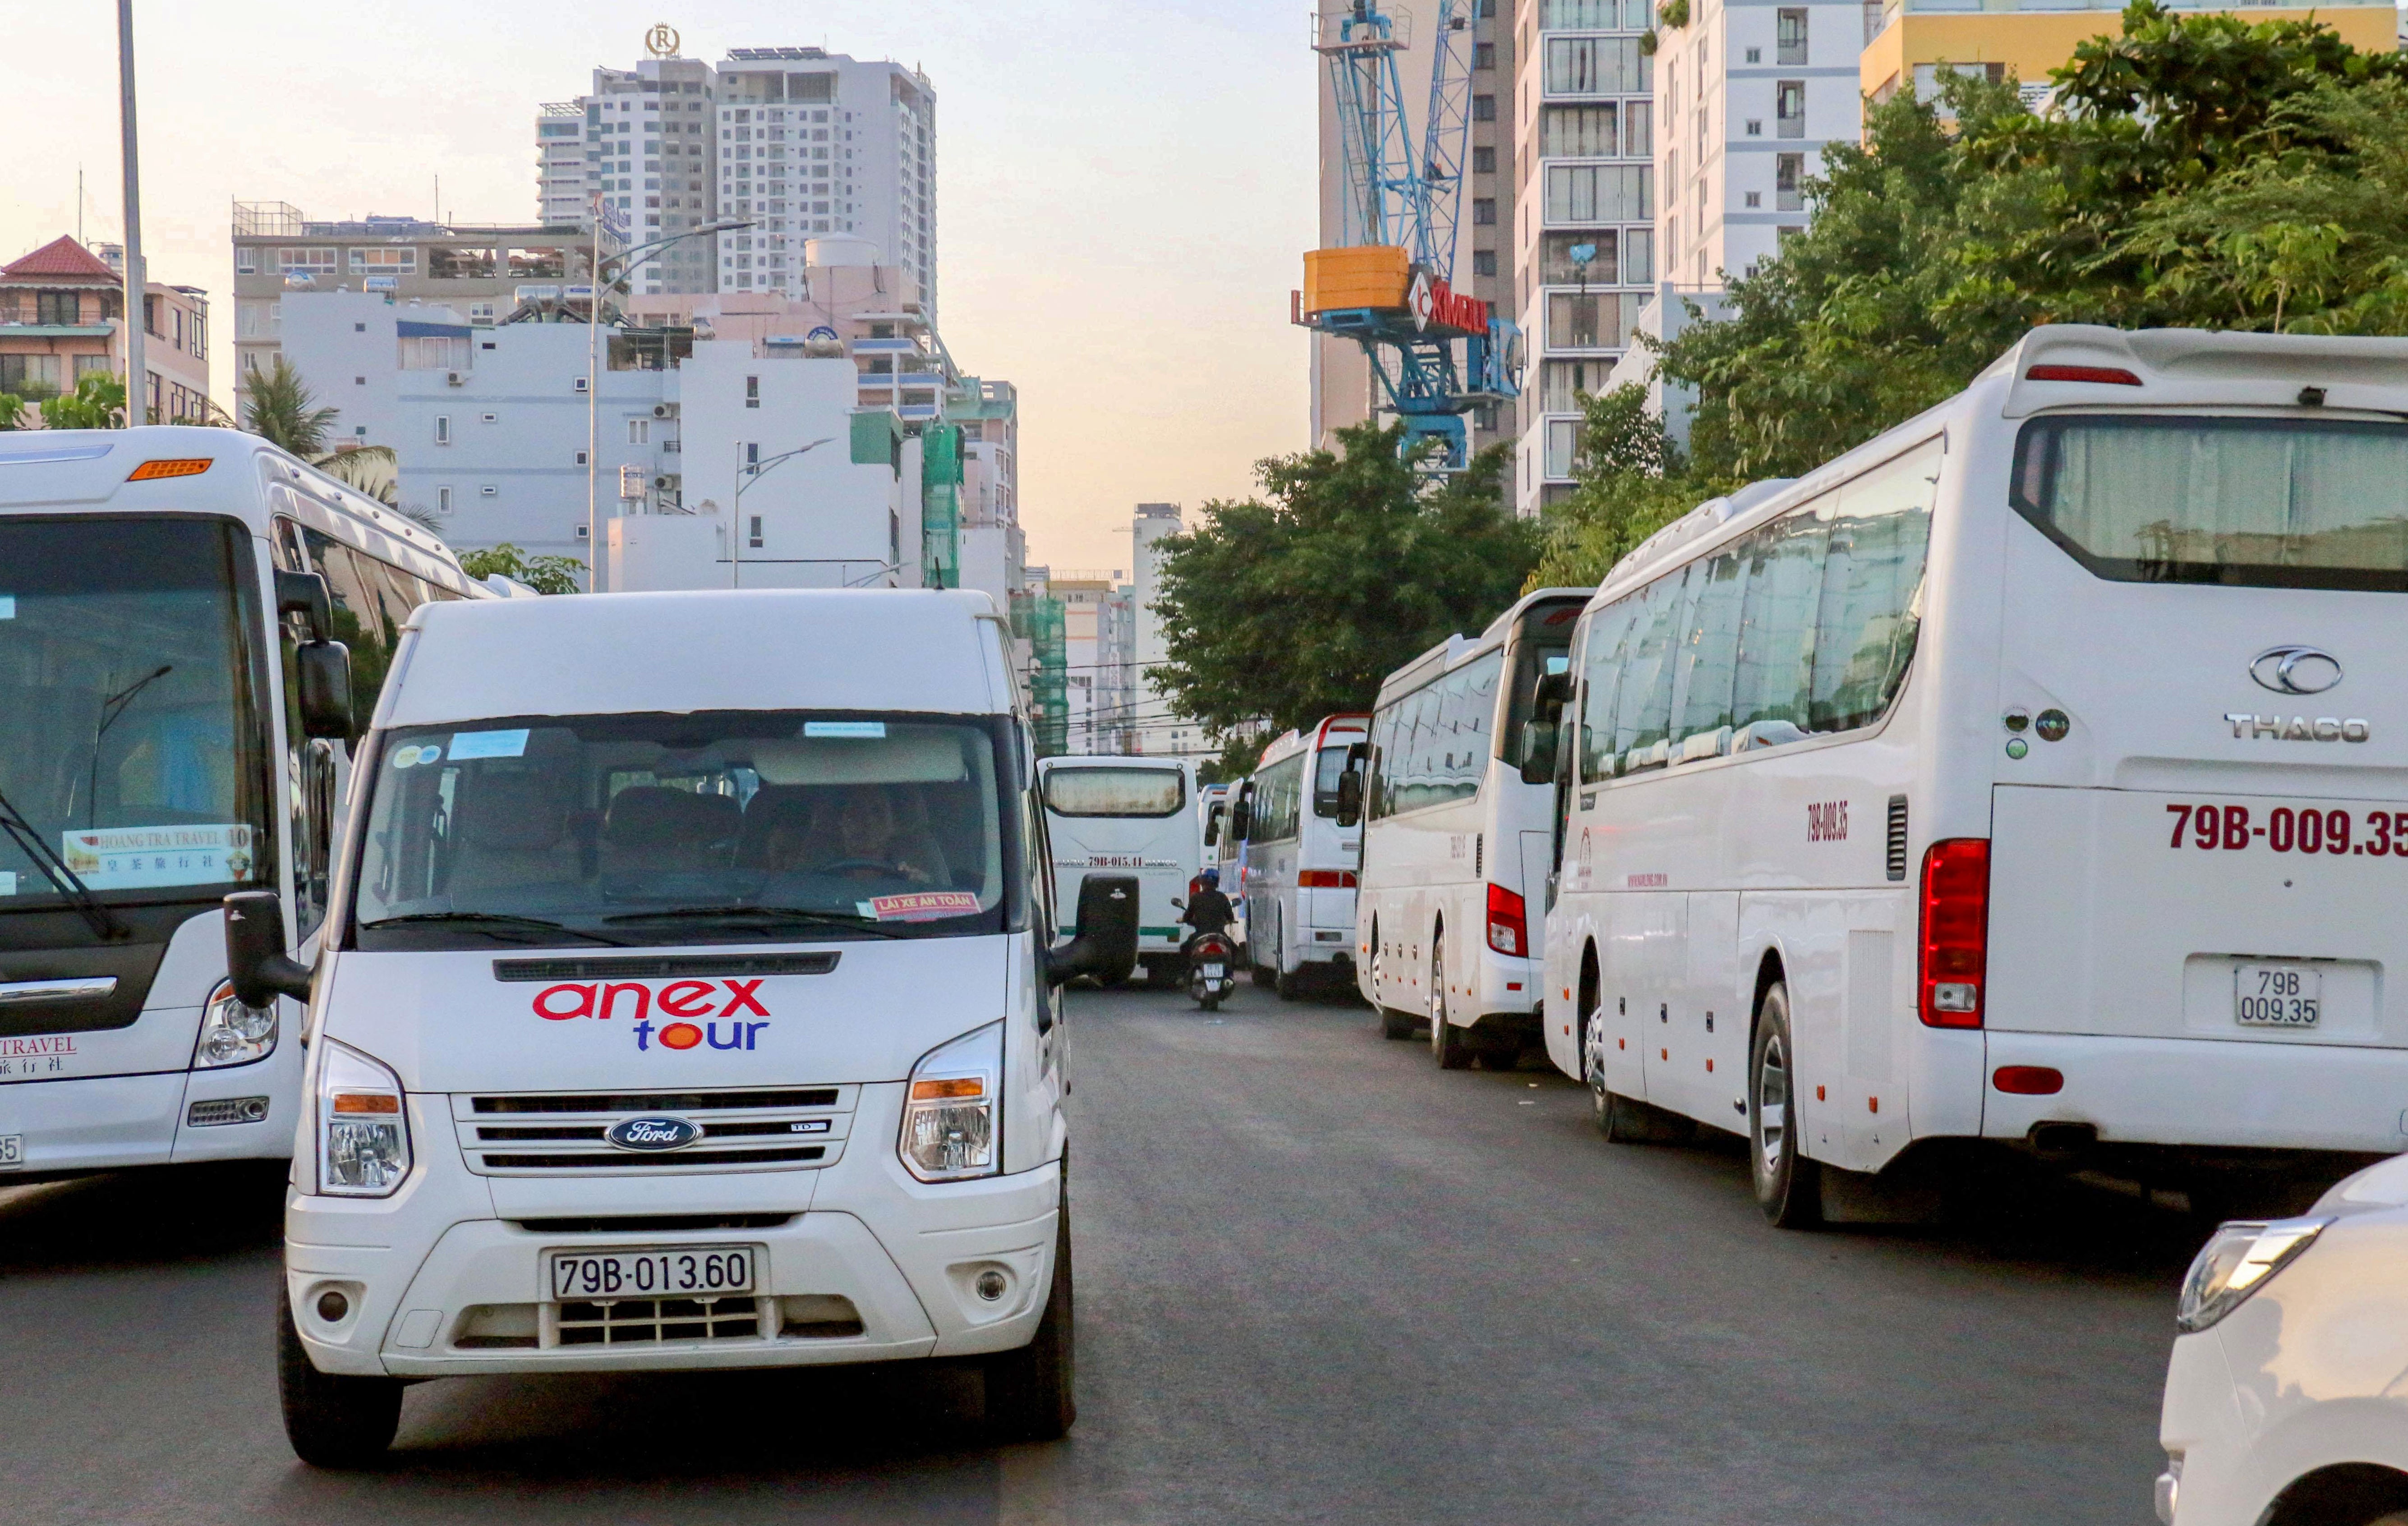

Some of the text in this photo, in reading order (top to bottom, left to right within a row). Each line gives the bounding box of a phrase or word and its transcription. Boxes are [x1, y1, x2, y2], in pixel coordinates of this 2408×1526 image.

[2224, 713, 2369, 743] THACO
[1808, 800, 1847, 842] 79B-009.35
[2166, 804, 2408, 857] 79B-009.35
[100, 834, 143, 848] HOANG
[174, 832, 221, 845] TRAVEL
[901, 897, 918, 908] XE
[921, 896, 936, 906] AN
[2259, 971, 2299, 994] 79B
[533, 979, 771, 1020] anex
[2241, 998, 2316, 1023] 009.35
[0, 1037, 77, 1055] TRAVEL
[633, 1020, 771, 1052] tour
[626, 1120, 678, 1143] Ford
[0, 1138, 17, 1160] 5
[560, 1253, 746, 1295] 79B-013.60
